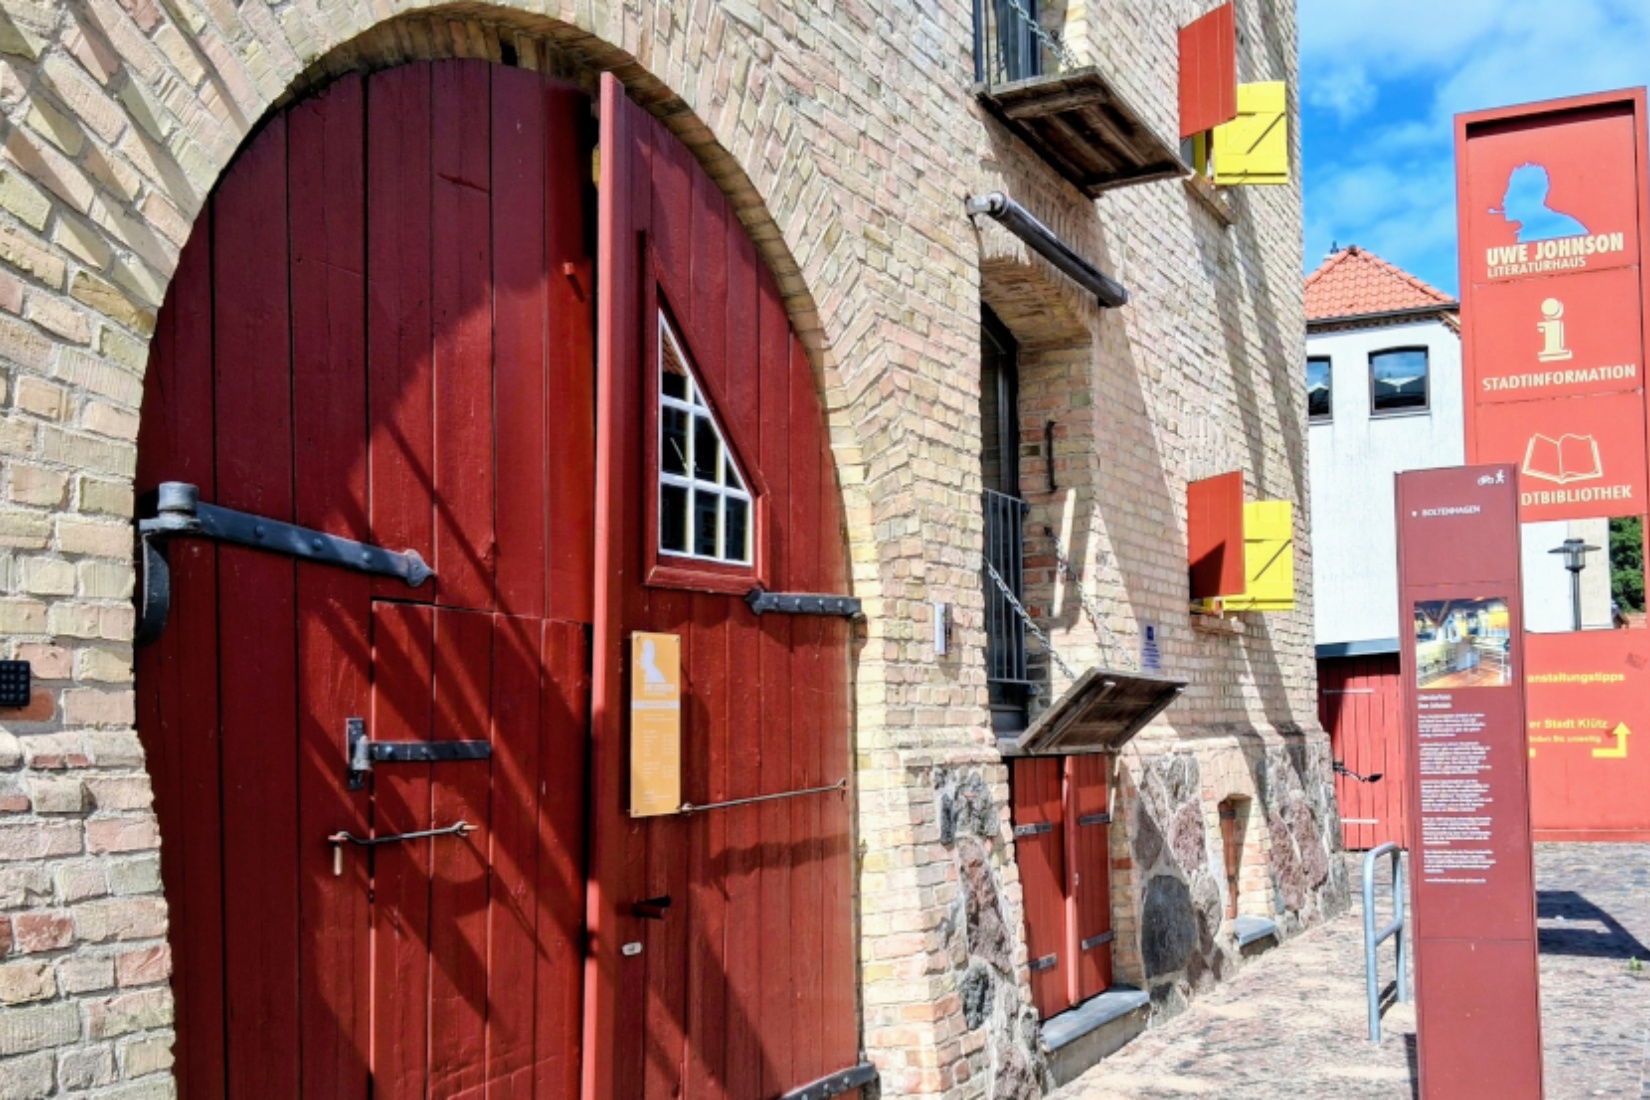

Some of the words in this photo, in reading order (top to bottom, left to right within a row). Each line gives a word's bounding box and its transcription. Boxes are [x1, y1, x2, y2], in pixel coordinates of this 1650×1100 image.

[1487, 244, 1528, 266] UWE
[1535, 232, 1624, 261] JOHNSON
[1487, 257, 1586, 279] LITERATURHAUS
[1482, 364, 1636, 391] STADTINFORMATION
[1521, 485, 1632, 506] DTBIBLIOTHEK
[1527, 672, 1625, 684] anstaltungstipps
[1545, 719, 1574, 728] Stadt
